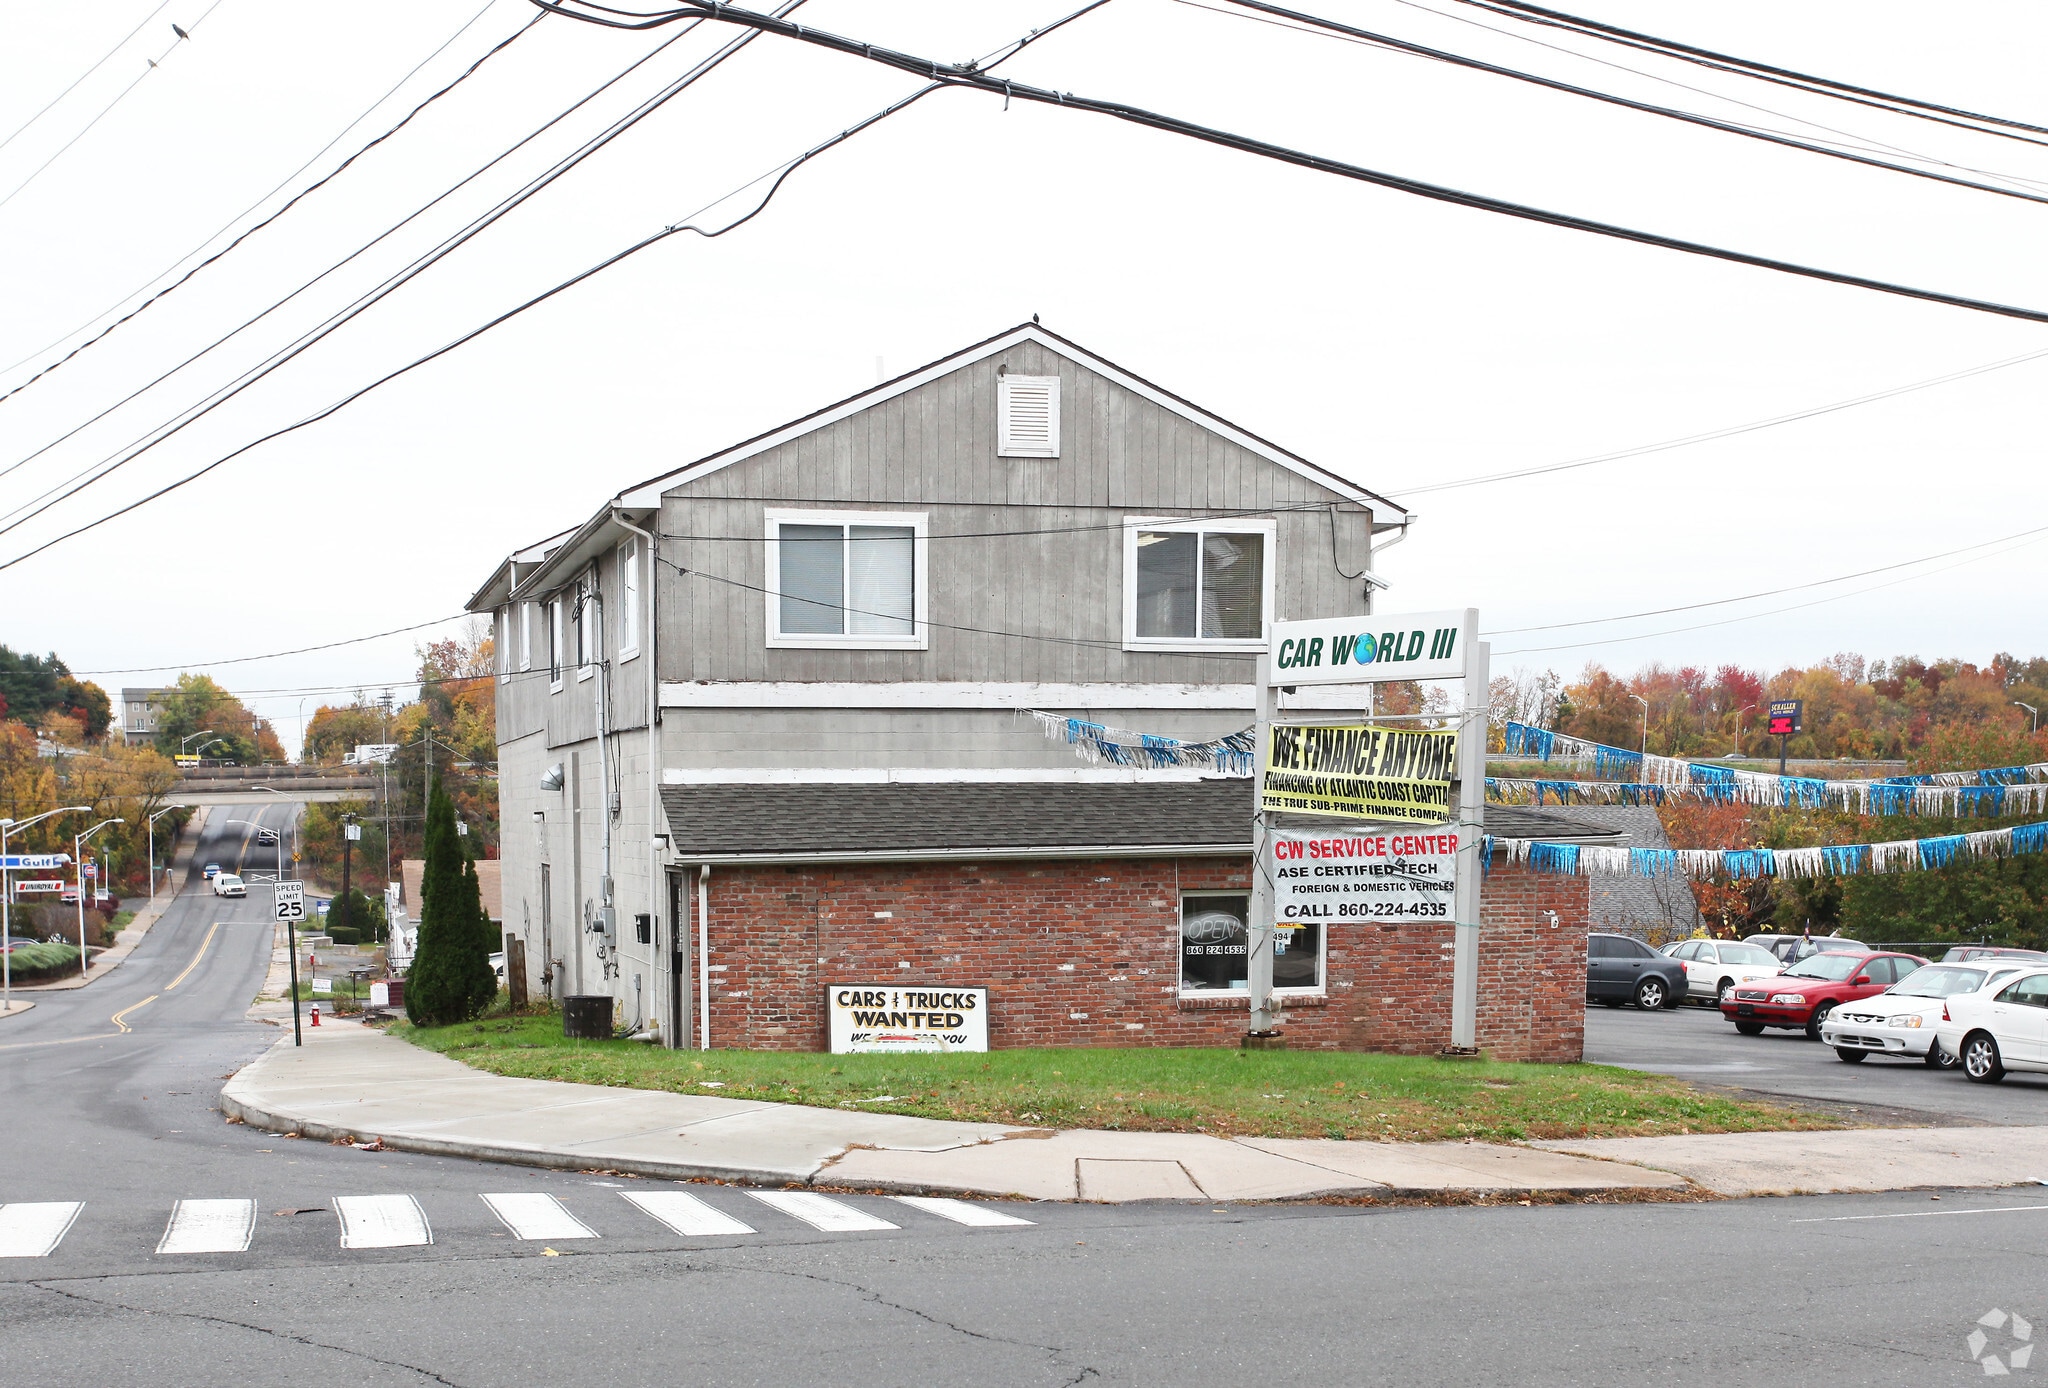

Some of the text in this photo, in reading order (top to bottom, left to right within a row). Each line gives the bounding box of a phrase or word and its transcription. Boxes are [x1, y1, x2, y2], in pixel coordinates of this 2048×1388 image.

[1277, 637, 1324, 669] CAR
[1429, 628, 1457, 660] III
[1272, 727, 1455, 781] WE FINANCE ANYONE
[1264, 771, 1449, 806] FINANCING BY ATLANTIC COAST CAPITA
[1262, 796, 1282, 806] THE
[1284, 797, 1308, 809] TRUE
[1311, 799, 1364, 814] SUB-PRIME
[1366, 804, 1407, 817] FINANCE
[1275, 835, 1458, 860] CW SERVICE CENTER
[22, 857, 50, 867] Gulf
[1277, 863, 1438, 878] ASE CERTIFIED TECH
[275, 884, 302, 892] SPEED
[1292, 881, 1455, 894] FOREIGN & DOMESTIC VEHICLES
[277, 902, 303, 917] 25
[1284, 903, 1447, 918] CALL 860-224-4535
[1188, 920, 1236, 939] OPEN
[1187, 945, 1247, 954] 860 224 4535
[836, 990, 887, 1009] CARS
[904, 992, 977, 1011] TRUCKS
[851, 1011, 965, 1030] WANTED
[942, 1034, 967, 1044] YOU
